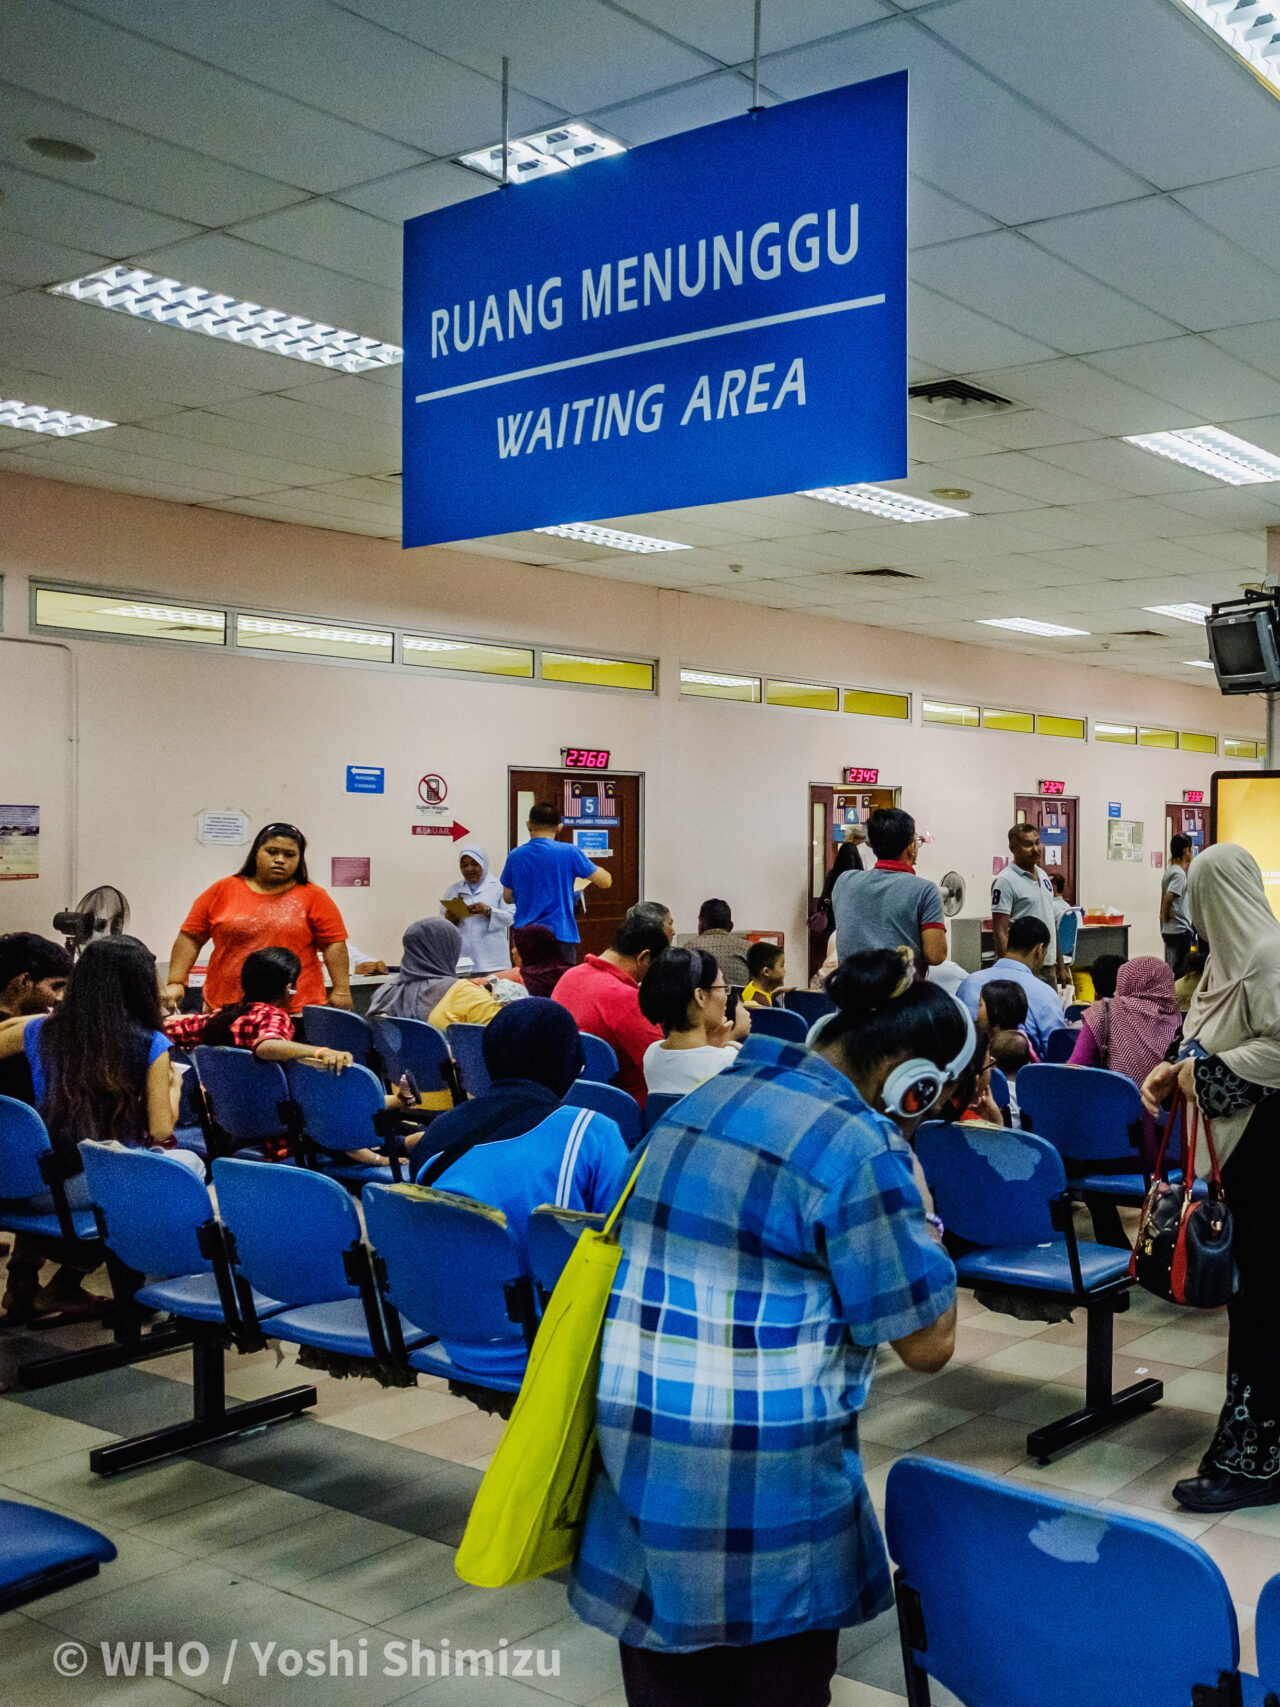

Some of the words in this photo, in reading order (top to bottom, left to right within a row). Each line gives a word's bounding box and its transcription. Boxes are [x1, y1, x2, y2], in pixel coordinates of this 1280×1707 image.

[431, 276, 563, 359] RUANG
[582, 204, 859, 321] MENUNGGU
[497, 383, 665, 459] WAITING
[681, 358, 806, 426] AREA
[566, 749, 608, 768] 2368
[848, 768, 878, 783] 2345
[585, 798, 594, 814] 5
[848, 810, 855, 821] 4
[992, 889, 1002, 905] 8
